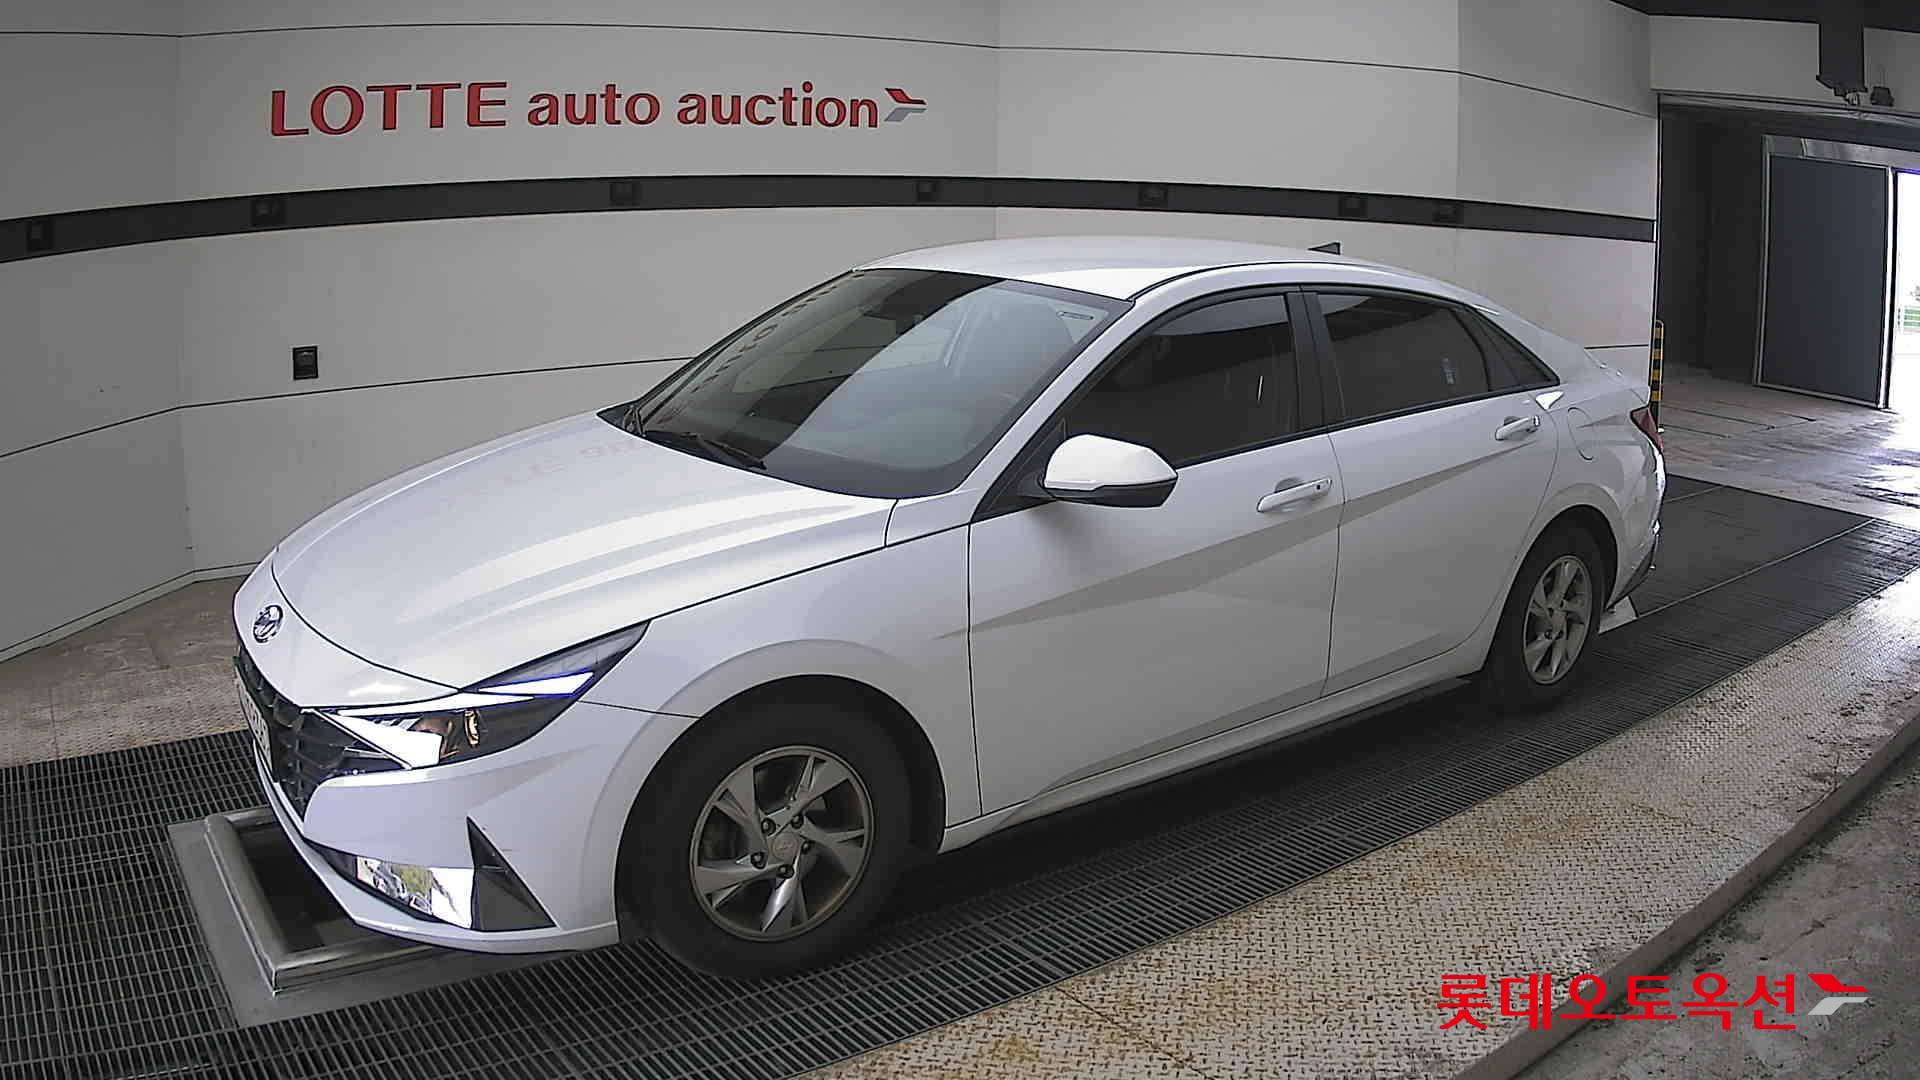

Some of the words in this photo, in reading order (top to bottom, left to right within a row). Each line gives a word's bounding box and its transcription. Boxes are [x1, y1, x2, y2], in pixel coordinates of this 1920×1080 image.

[271, 82, 508, 136] LOTTE
[527, 83, 661, 126] auto
[677, 81, 879, 127] auction
